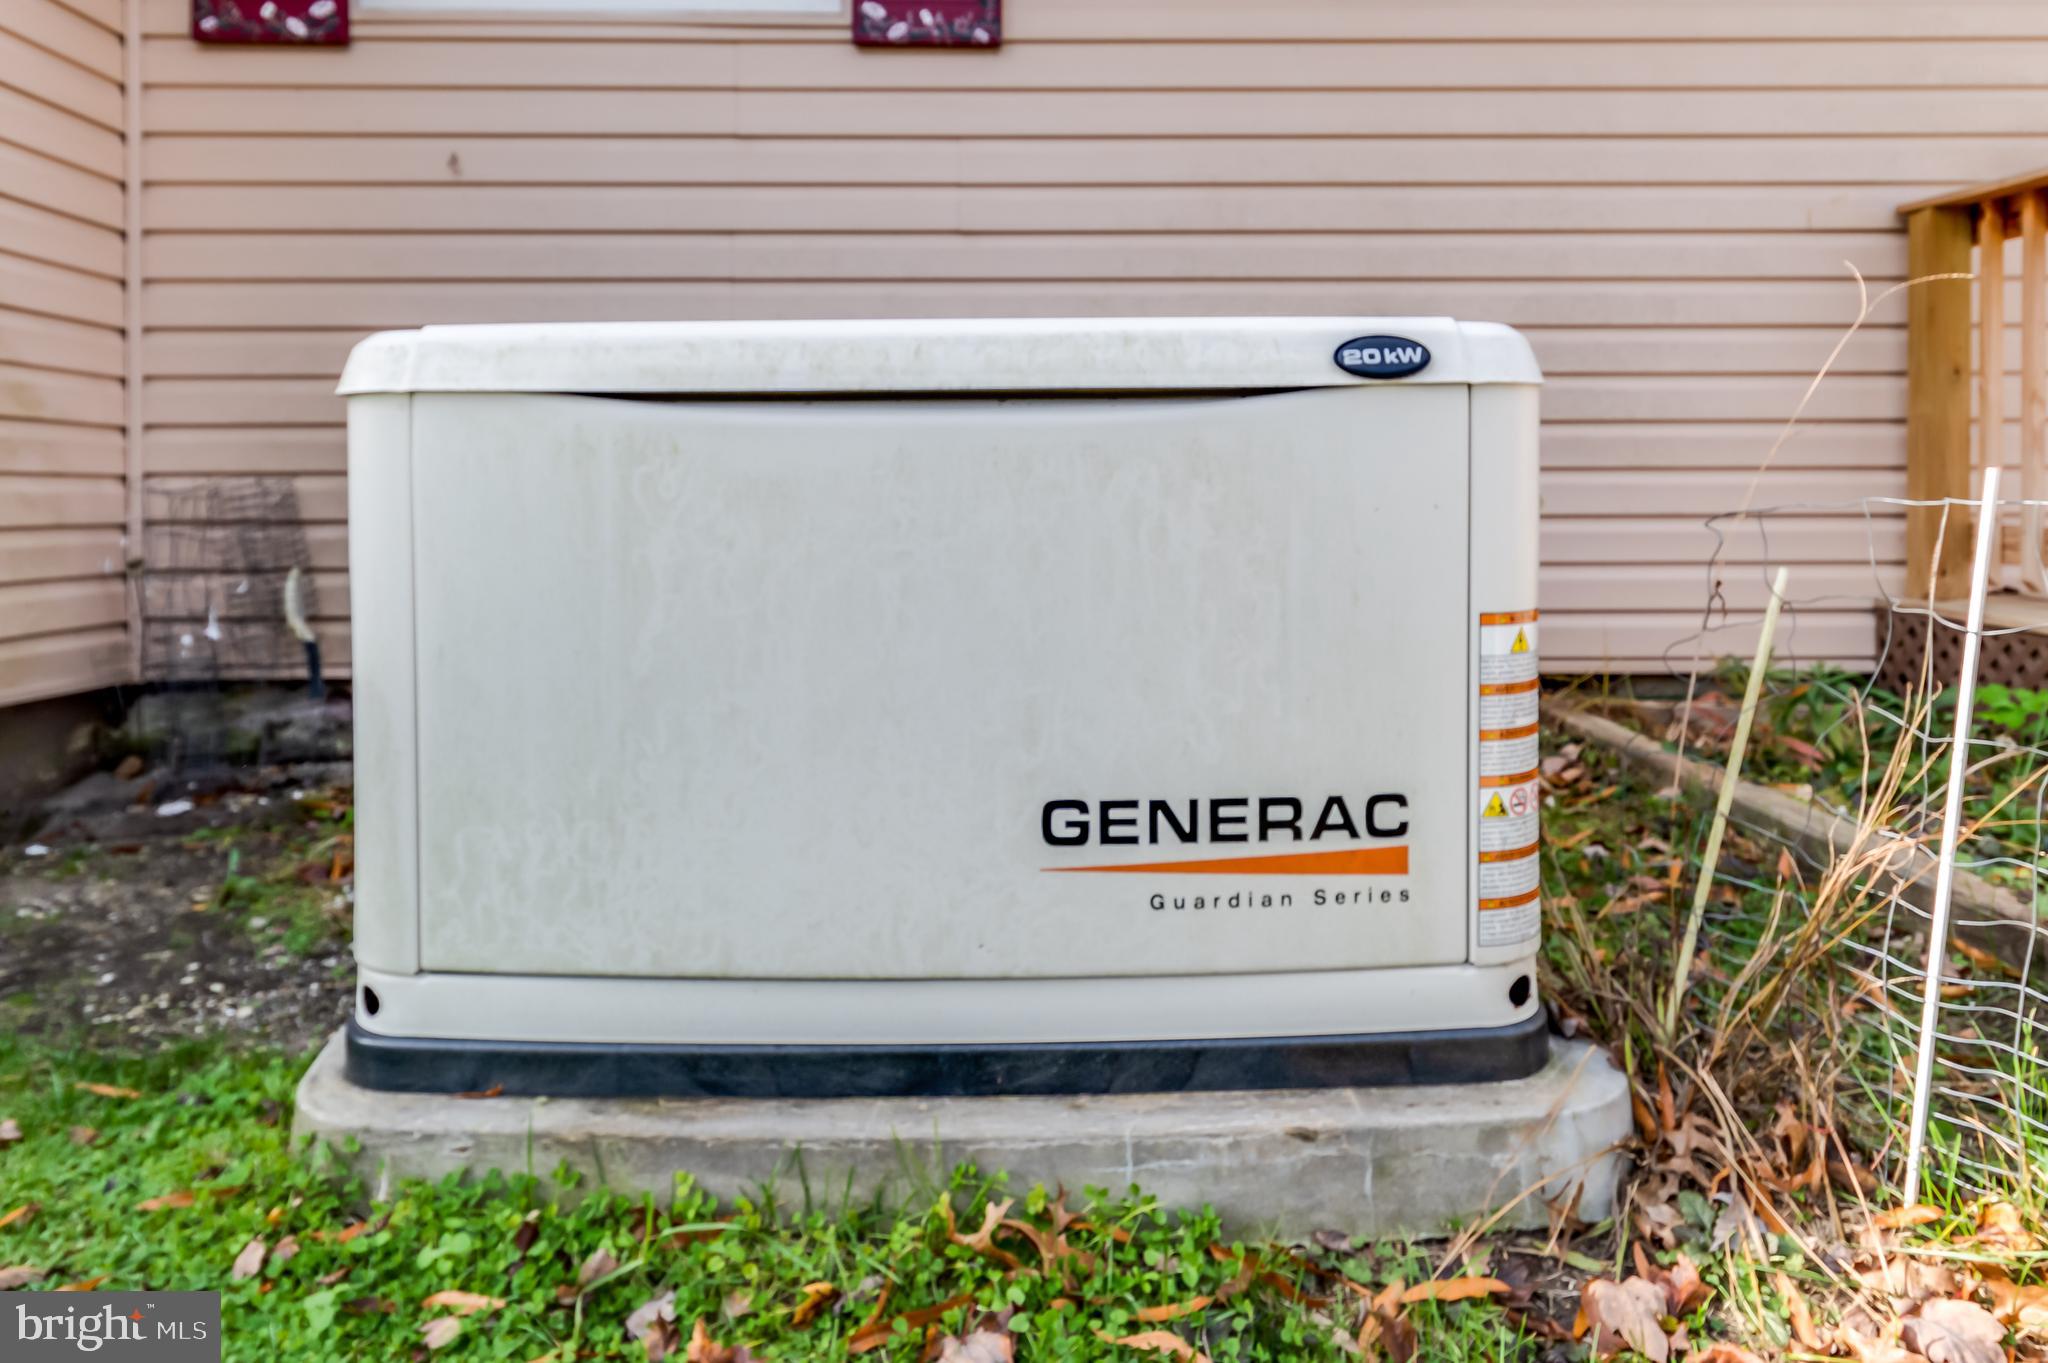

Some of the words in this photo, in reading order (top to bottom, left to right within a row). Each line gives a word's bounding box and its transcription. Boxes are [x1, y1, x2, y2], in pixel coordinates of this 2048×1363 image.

[1041, 793, 1409, 846] GENERAC
[1149, 892, 1293, 910] Guardian
[1313, 887, 1410, 906] Series
